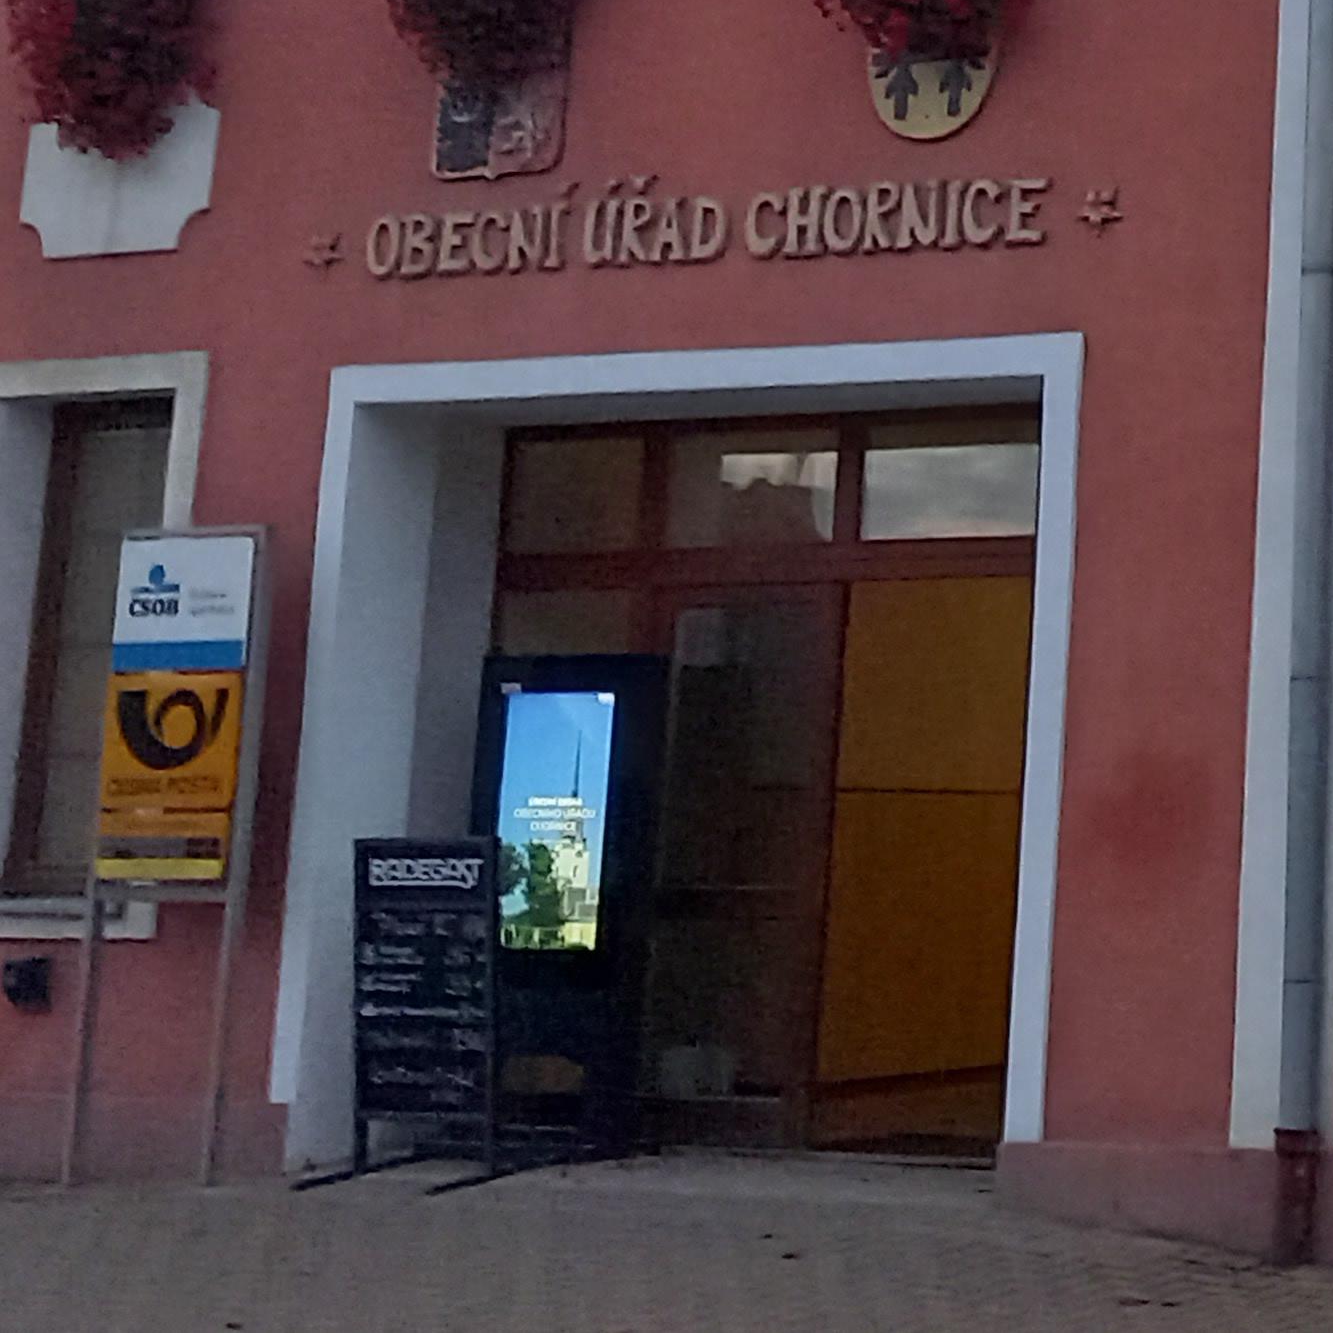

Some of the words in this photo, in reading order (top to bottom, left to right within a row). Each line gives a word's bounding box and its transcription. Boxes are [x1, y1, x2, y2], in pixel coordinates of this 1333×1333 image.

[366, 181, 580, 279] OBECNÍ
[583, 174, 732, 266] ÚŘAD
[745, 178, 1053, 259] CHORNICE
[368, 857, 484, 888] RADEGAST
